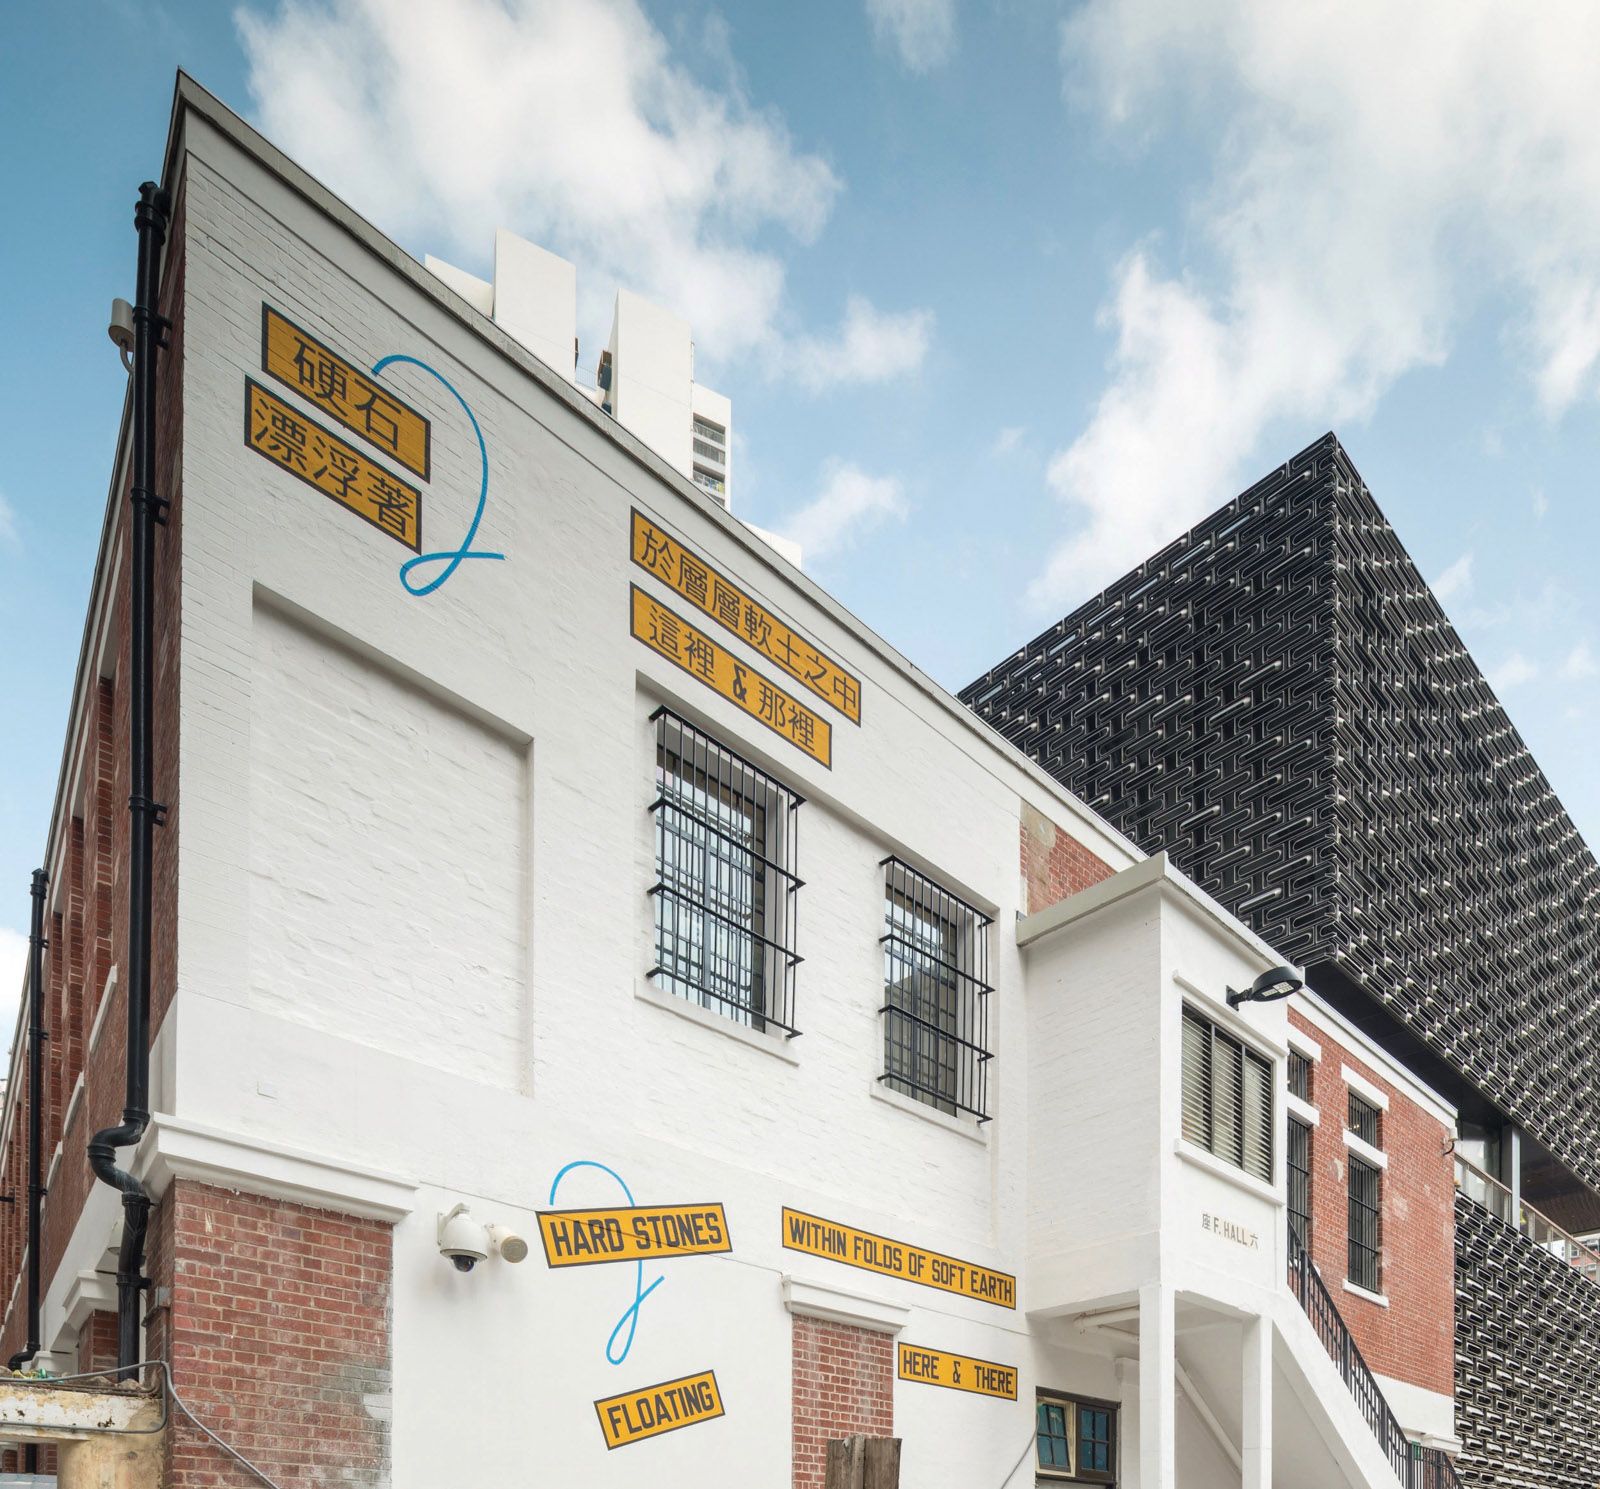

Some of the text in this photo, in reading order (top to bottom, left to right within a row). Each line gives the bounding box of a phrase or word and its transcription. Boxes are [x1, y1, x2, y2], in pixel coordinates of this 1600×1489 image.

[292, 335, 402, 451] 硬石
[254, 398, 415, 537] 漂浮著
[641, 528, 857, 711] 於層層軟土之中
[648, 604, 816, 752] 這裡 & 那裡
[549, 1212, 723, 1257] HARD STONES
[789, 1216, 1012, 1303] WITHIN FOLDS OF SOFT EARTH
[1223, 1220, 1248, 1246] HALL
[606, 1381, 715, 1439] FLOATING
[903, 1350, 1014, 1395] HERE & THERE
